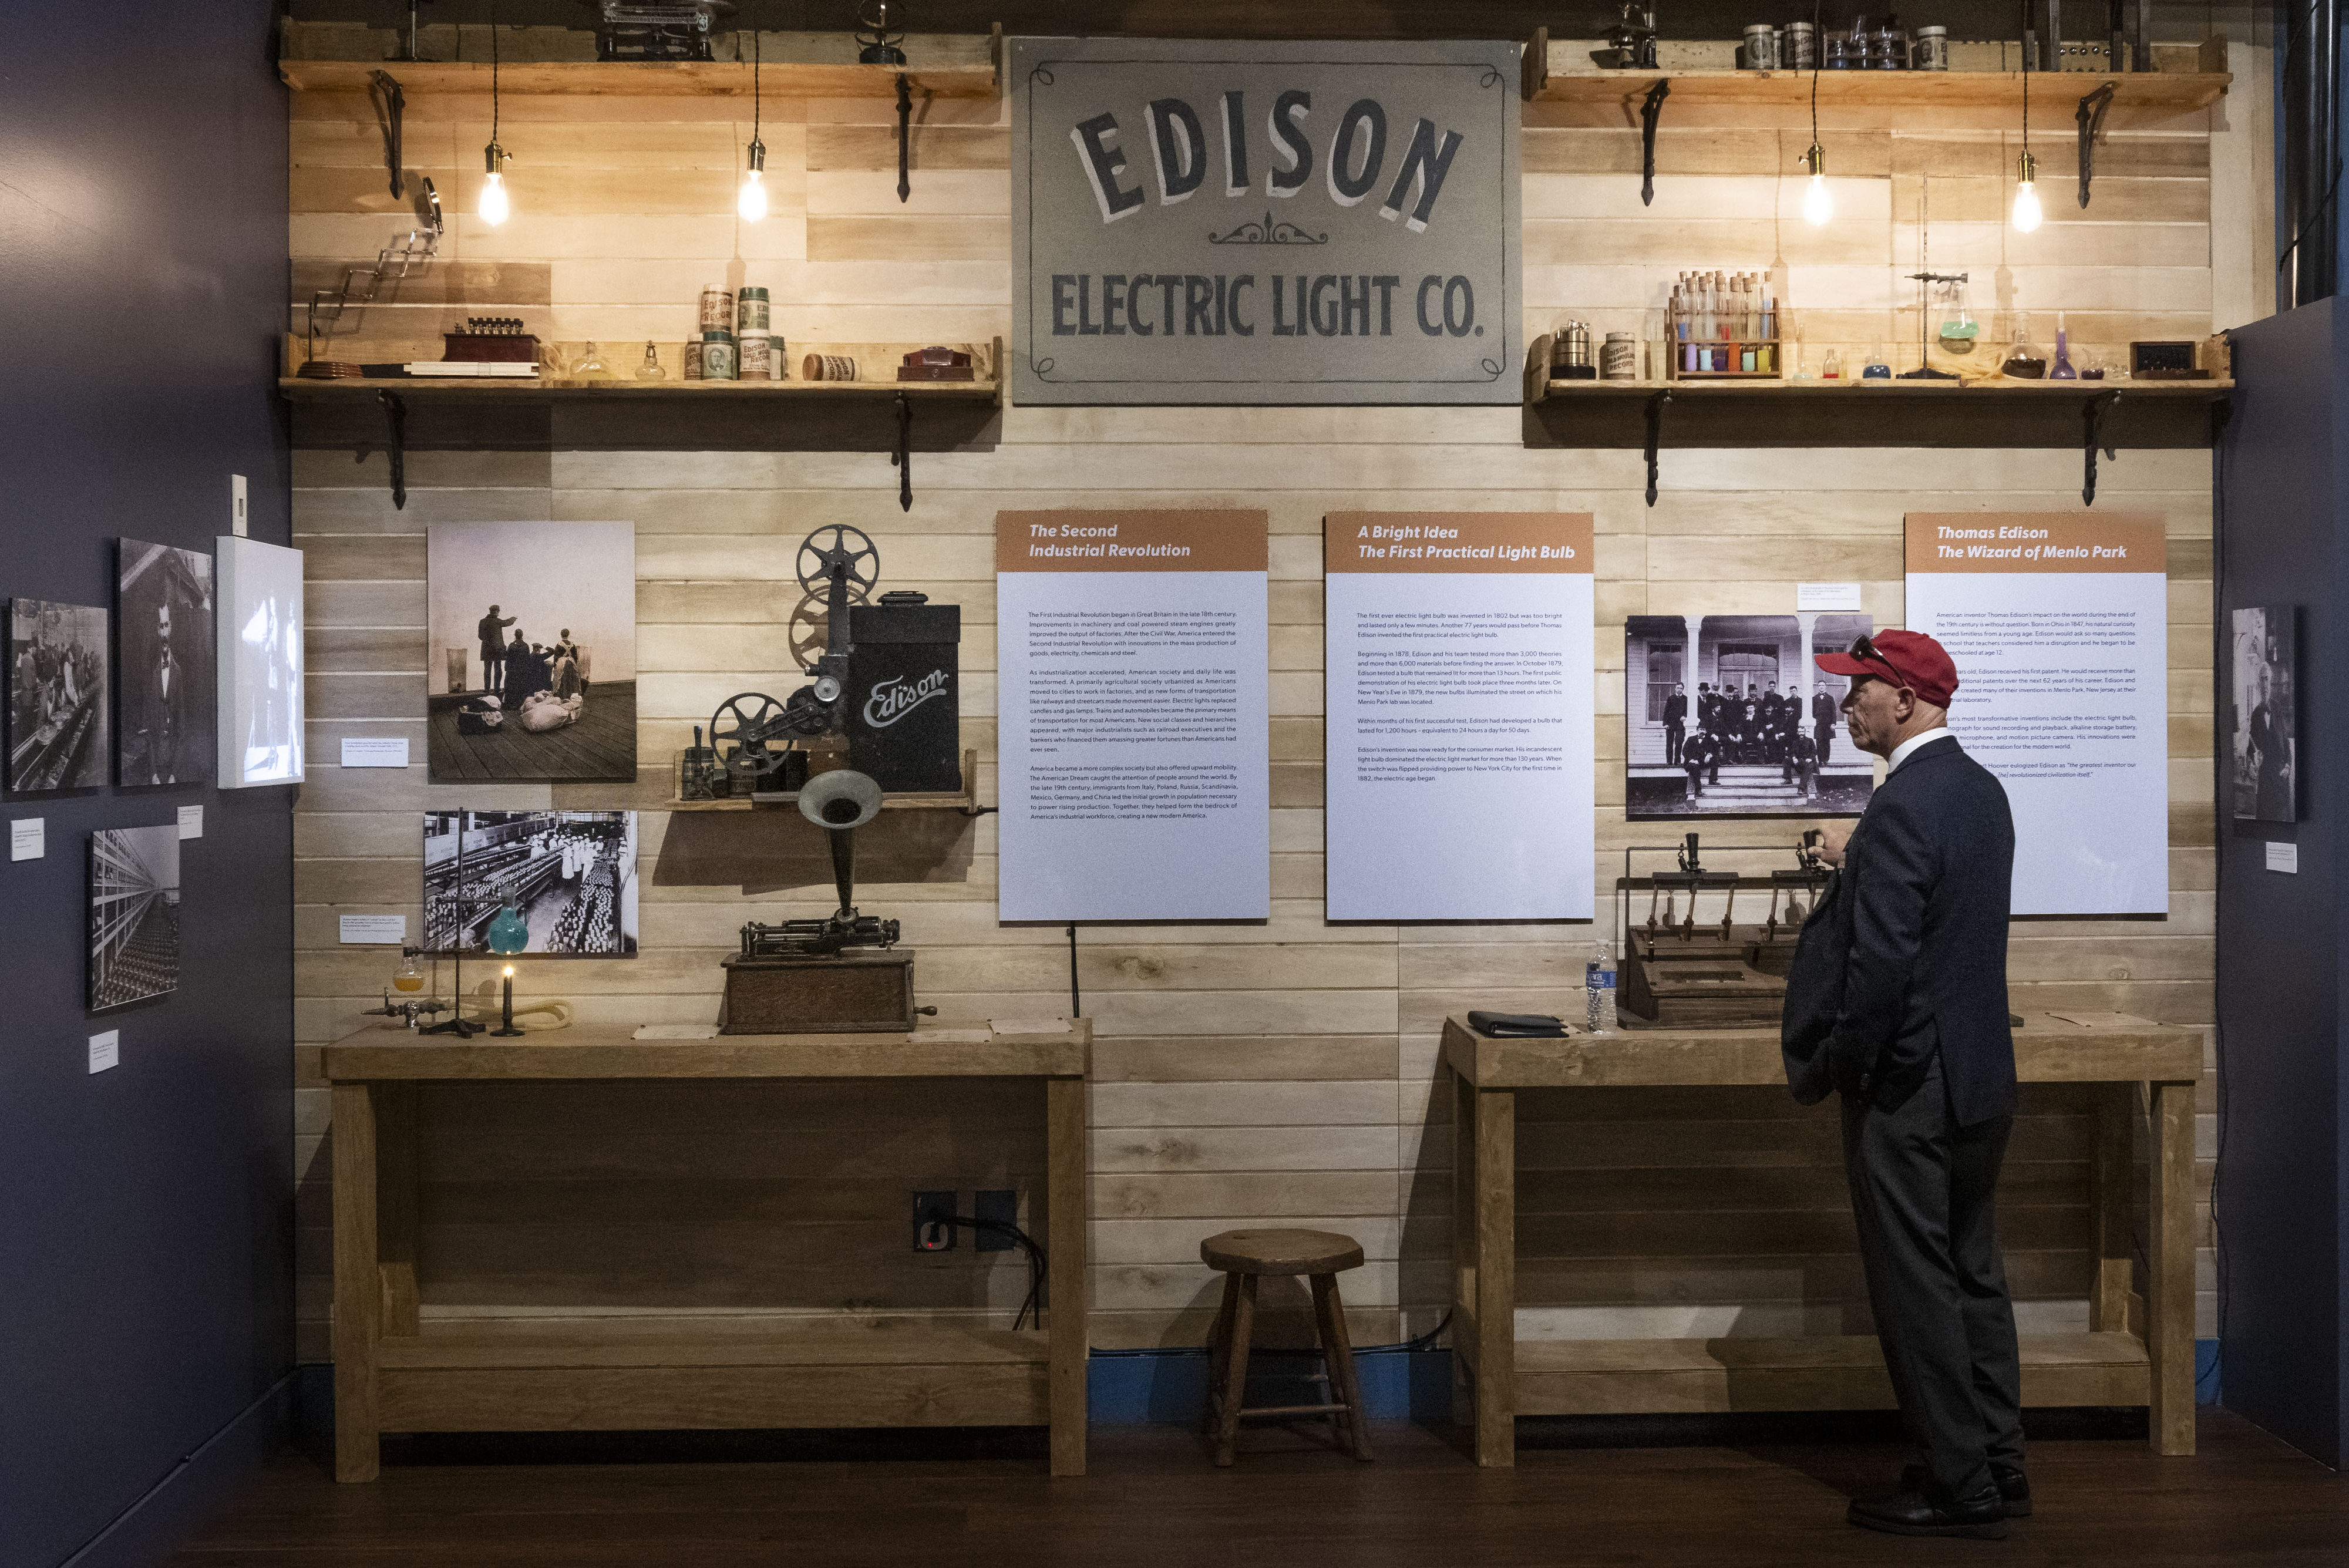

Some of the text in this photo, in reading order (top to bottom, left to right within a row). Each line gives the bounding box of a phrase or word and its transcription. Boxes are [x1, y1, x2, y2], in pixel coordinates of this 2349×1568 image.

[1070, 90, 1464, 234] EDISON
[1051, 274, 1485, 338] ELECTRIC LIGHT CO.
[705, 311, 732, 321] RECOR
[744, 342, 766, 352] EDISON
[751, 355, 770, 364] RECO
[1610, 361, 1633, 371] RECORD
[1029, 524, 1117, 537] The Second
[1358, 526, 1458, 541] A Bright Idea
[1937, 527, 2048, 540] Thomas Edison
[1030, 544, 1191, 557] Industrial Revolution
[1358, 546, 1575, 561] The First Practical Light Bulb
[1937, 546, 2127, 561] The Wizard of Menlo Park
[864, 669, 949, 728] Edison
